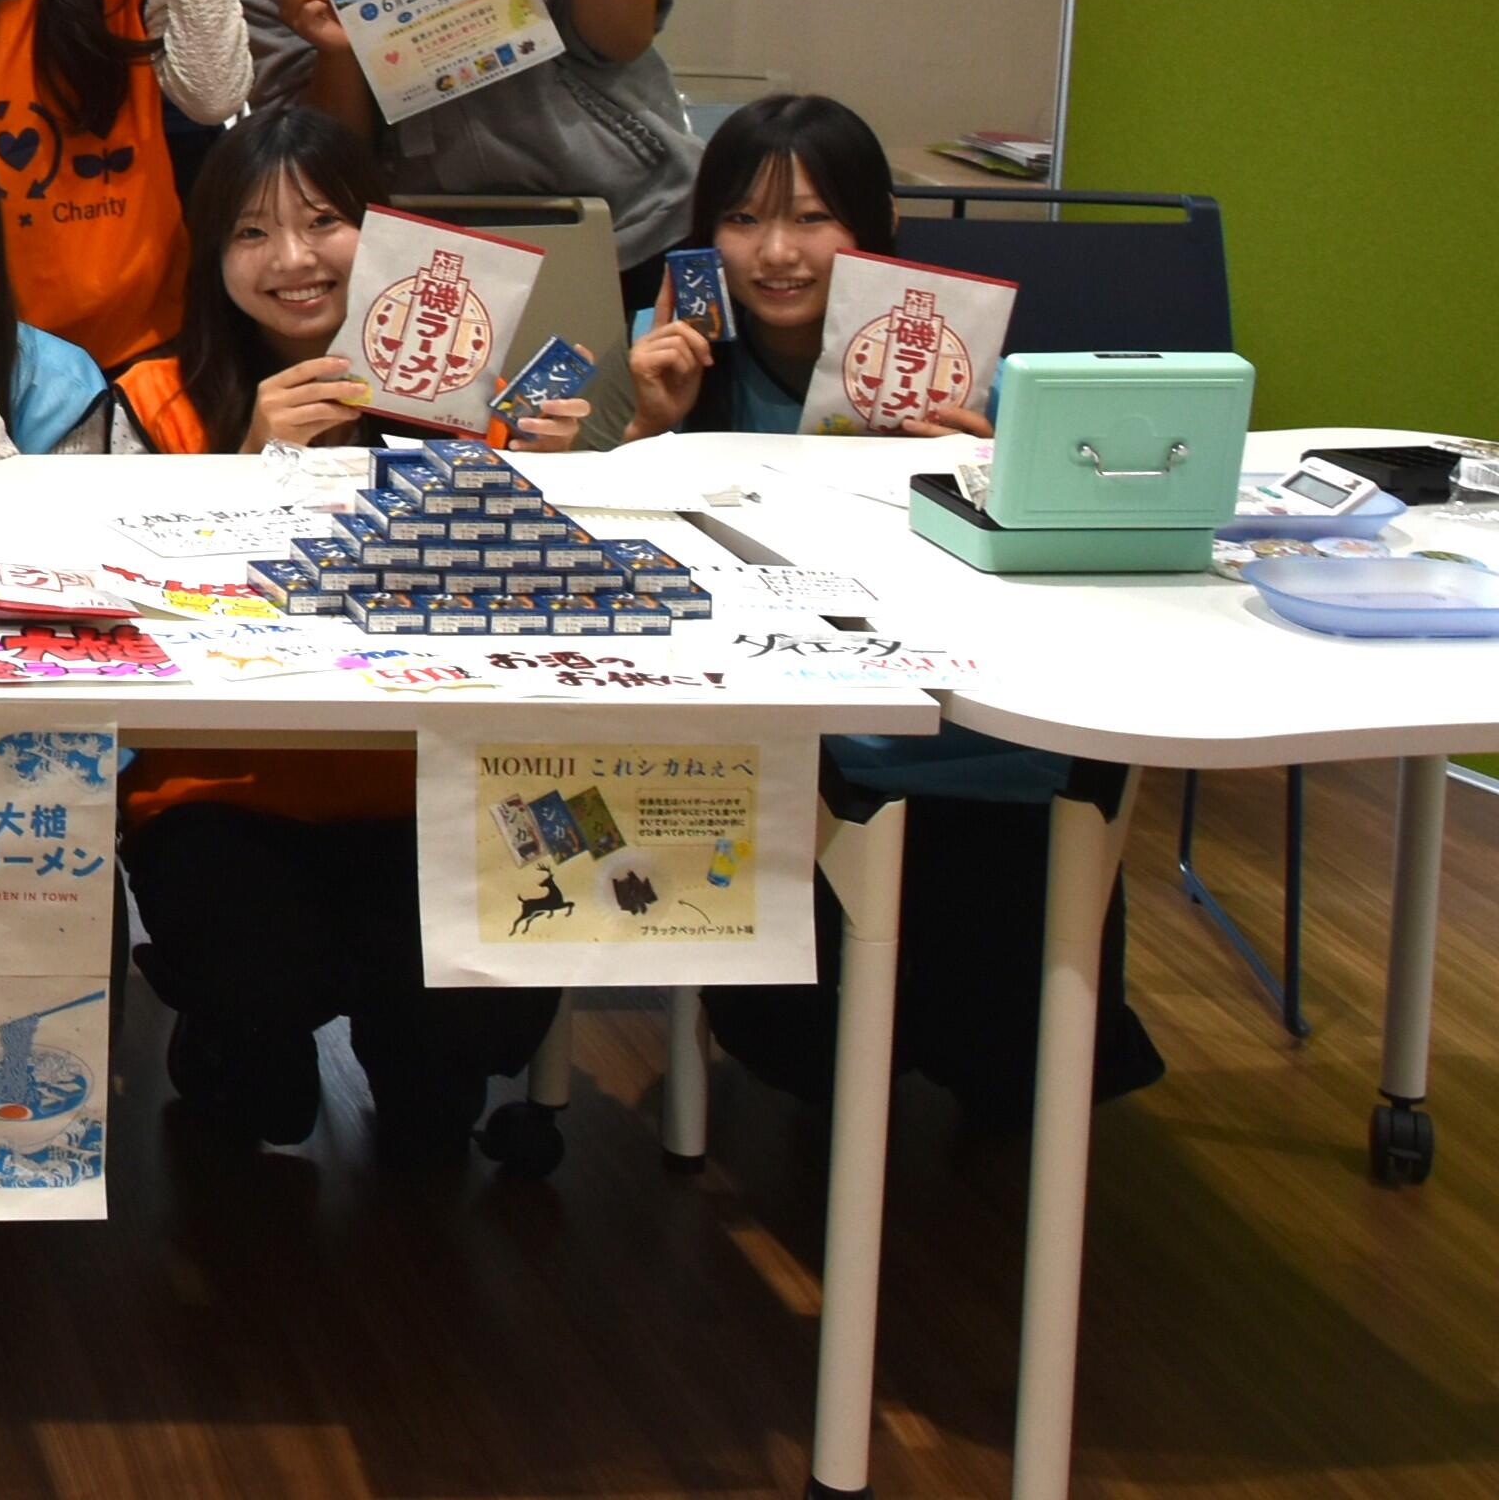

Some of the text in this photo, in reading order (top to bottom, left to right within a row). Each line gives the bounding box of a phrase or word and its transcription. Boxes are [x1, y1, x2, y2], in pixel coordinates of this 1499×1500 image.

[52, 197, 127, 223] Charity
[684, 269, 707, 316] シカ
[395, 279, 462, 395] 磯ラーメン
[733, 633, 948, 657] ダイエッター
[485, 651, 636, 669] お酒の
[480, 757, 755, 777] MOMIJI これシカねぇべ
[23, 892, 37, 901] IN
[42, 892, 79, 902] TOWN
